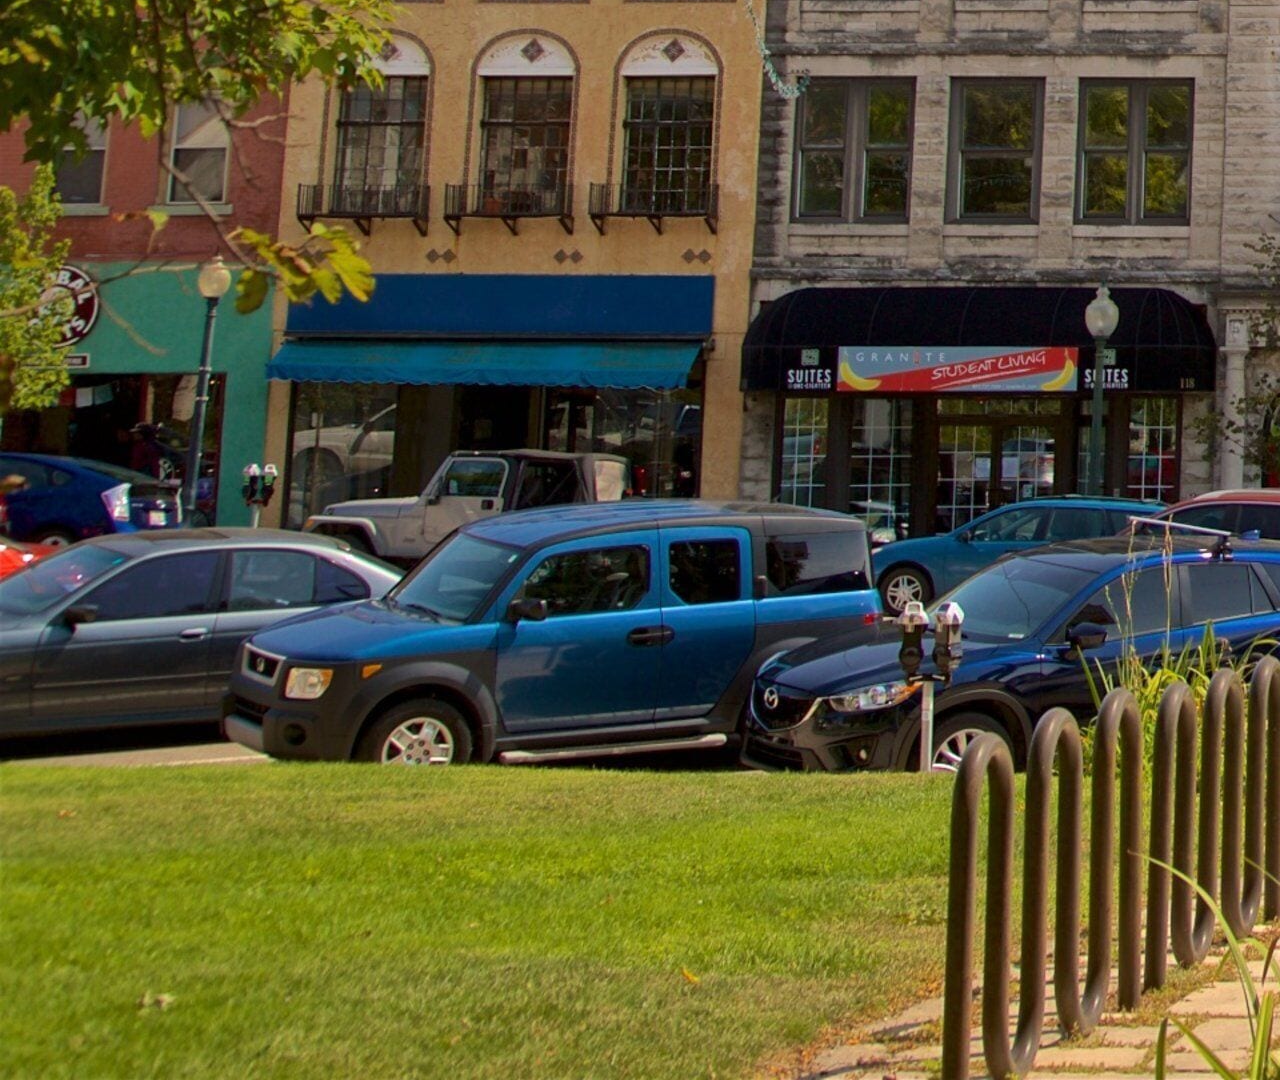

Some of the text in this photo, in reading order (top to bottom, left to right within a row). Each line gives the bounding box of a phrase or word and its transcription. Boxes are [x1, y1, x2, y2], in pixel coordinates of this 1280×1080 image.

[787, 368, 832, 384] SUITES
[931, 351, 1047, 381] STUDENT LIVING
